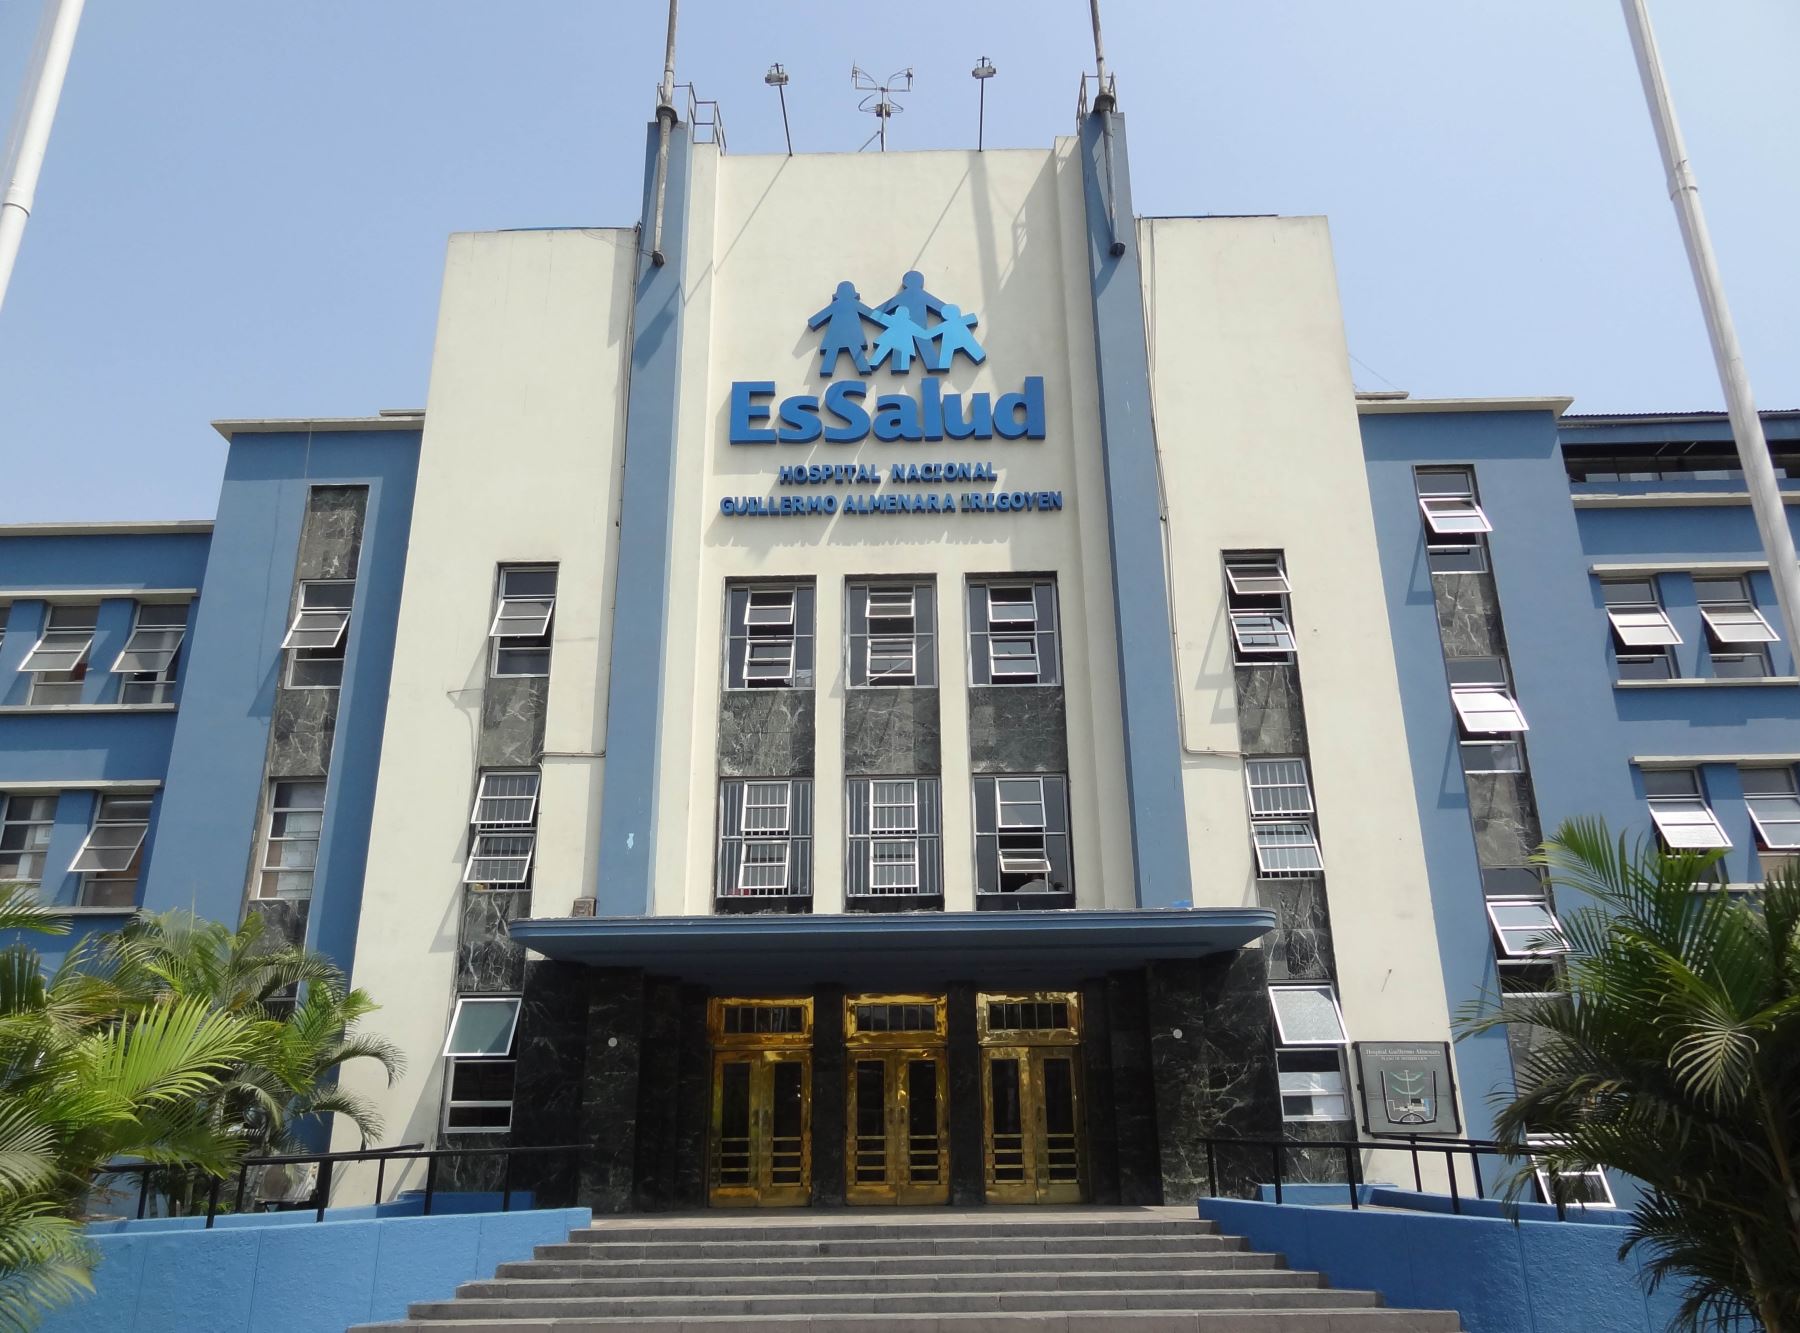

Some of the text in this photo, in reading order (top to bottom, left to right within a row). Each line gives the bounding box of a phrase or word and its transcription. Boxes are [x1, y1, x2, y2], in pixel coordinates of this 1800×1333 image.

[729, 376, 1046, 445] EsSalud
[779, 462, 997, 485] HOSPITAL NACIONAL
[719, 491, 1062, 516] GUILLERMO ALMENARA IRIGOYEN
